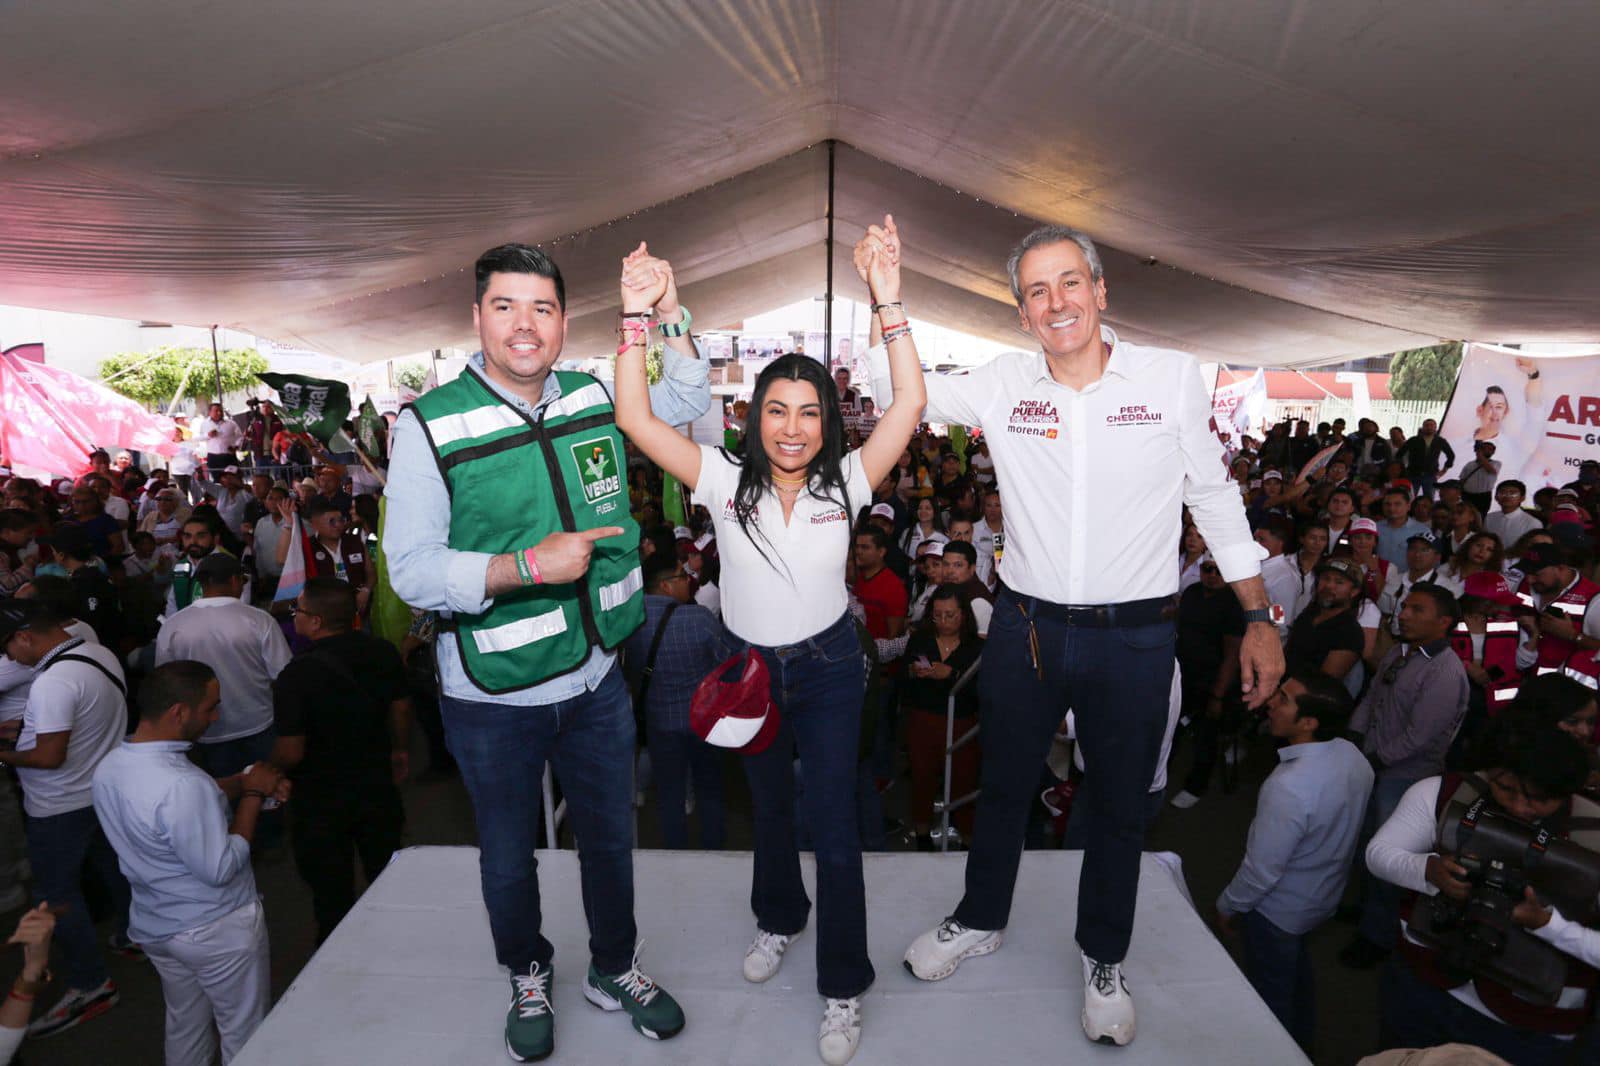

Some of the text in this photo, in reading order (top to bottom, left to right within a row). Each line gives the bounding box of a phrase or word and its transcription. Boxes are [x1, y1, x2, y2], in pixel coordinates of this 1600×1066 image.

[1039, 400, 1050, 408] LA
[1012, 407, 1057, 416] PUEBLA
[1120, 405, 1147, 414] PEPE
[1106, 413, 1161, 422] CHEDRAUI
[1008, 425, 1046, 436] morena
[1585, 433, 1600, 445] G
[1564, 457, 1585, 467] HO
[585, 475, 619, 499] VERDE
[811, 511, 841, 525] morena
